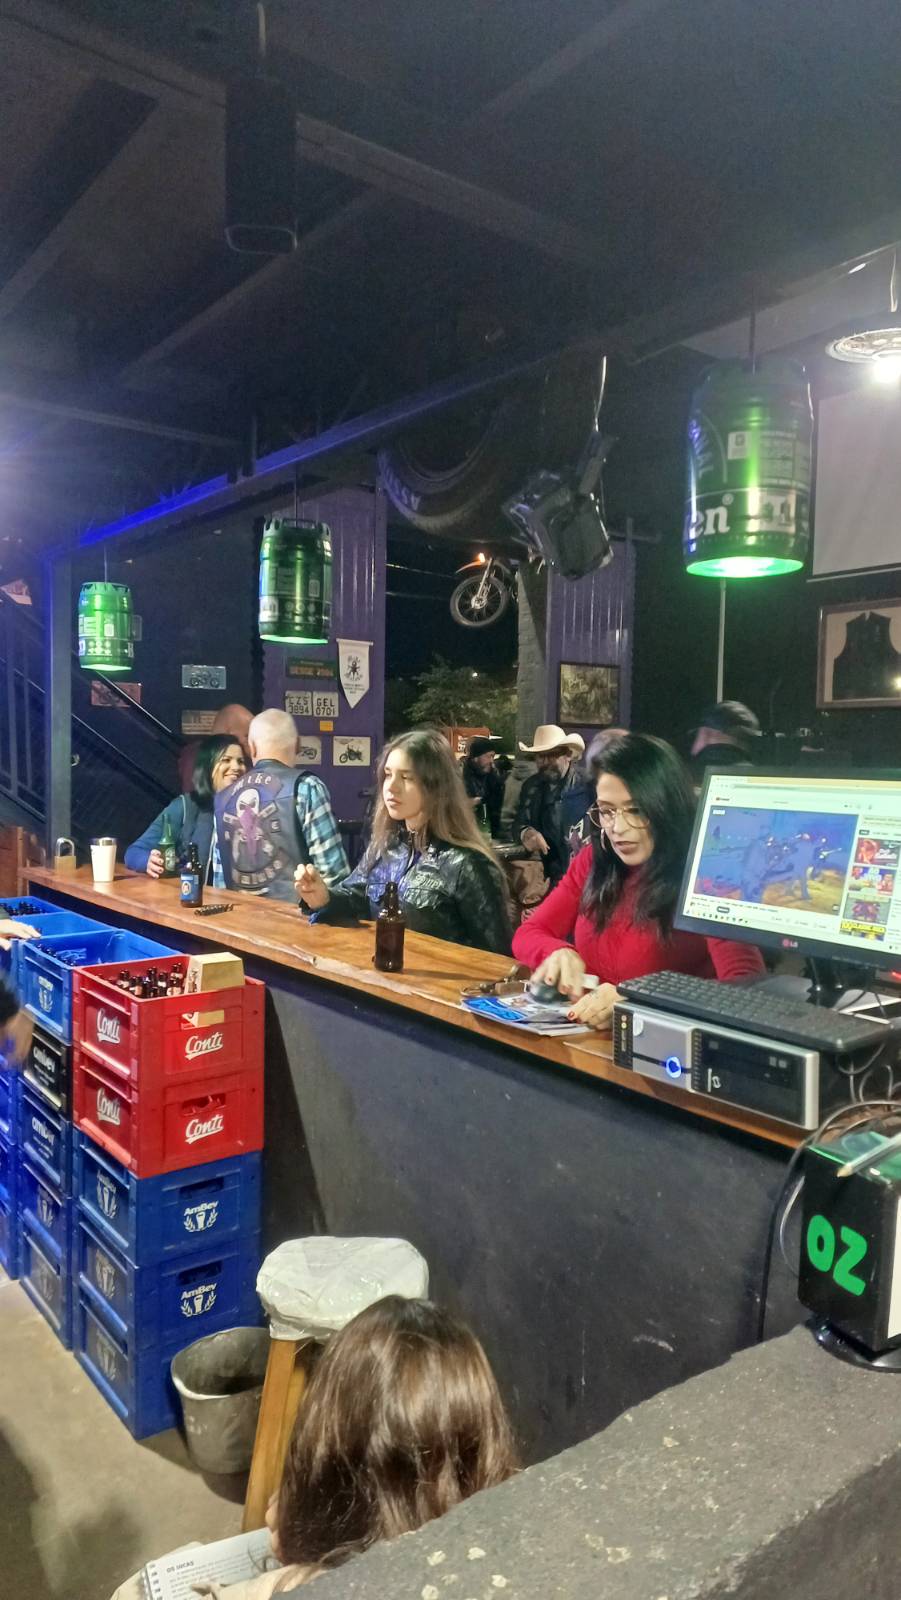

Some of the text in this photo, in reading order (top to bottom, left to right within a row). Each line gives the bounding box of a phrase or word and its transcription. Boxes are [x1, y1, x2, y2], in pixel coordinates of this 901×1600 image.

[316, 698, 335, 707] GEL
[96, 1008, 121, 1043] Conti
[184, 1031, 223, 1060] Conti
[96, 1088, 121, 1125] Conti
[184, 1114, 224, 1144] Conti
[183, 1200, 219, 1216] AmBev
[806, 1214, 868, 1297] 02
[180, 1282, 217, 1300] AmBev
